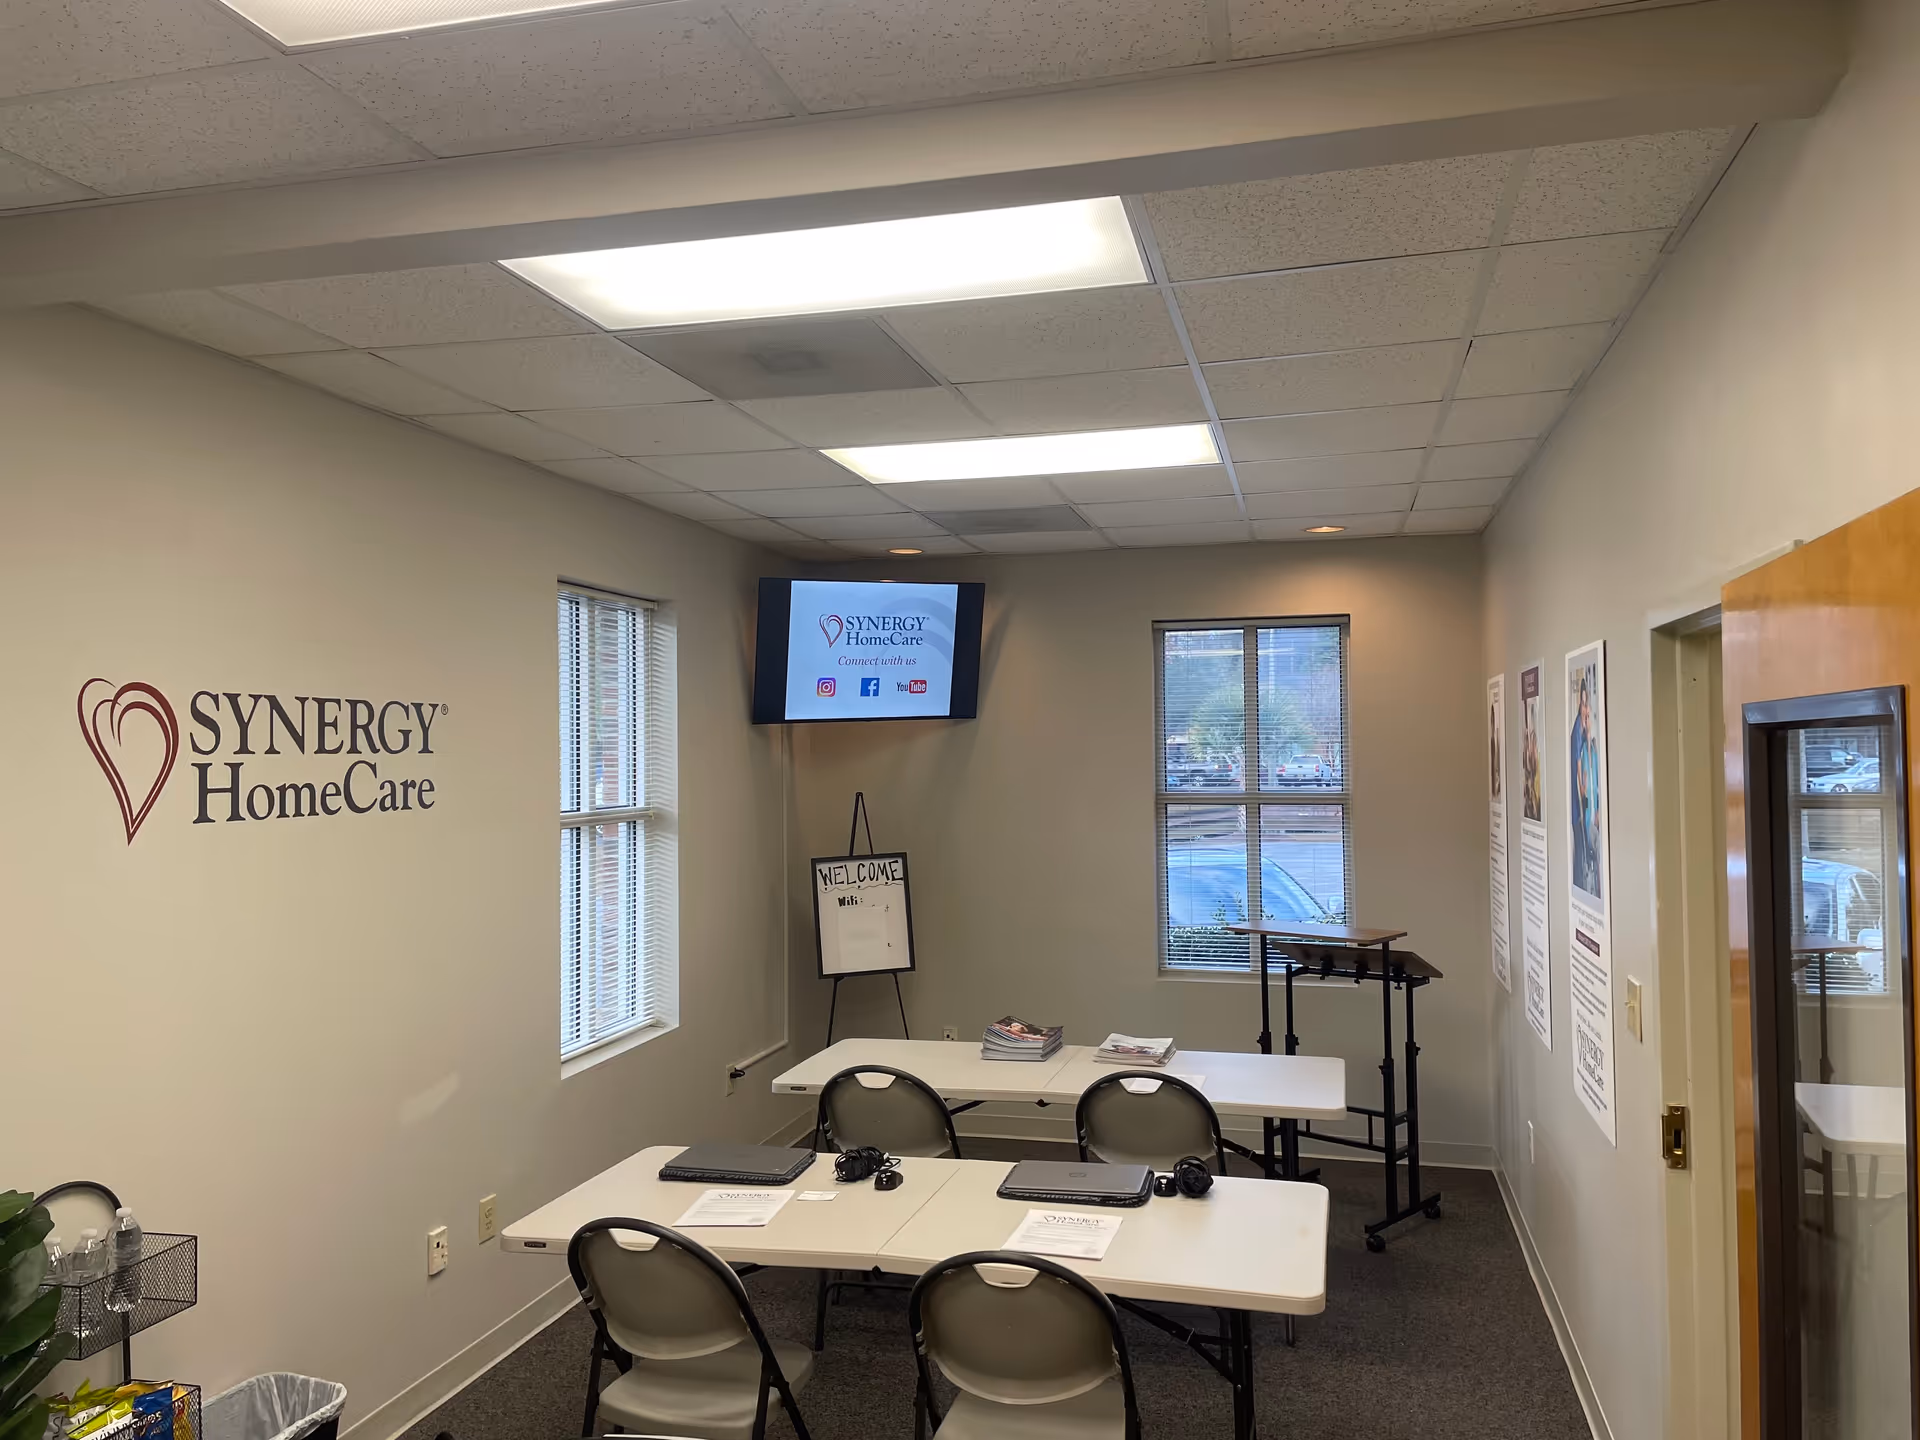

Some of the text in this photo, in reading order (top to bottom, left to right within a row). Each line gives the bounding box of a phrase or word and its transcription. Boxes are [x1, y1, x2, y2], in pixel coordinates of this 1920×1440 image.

[845, 632, 923, 646] HomeCare
[838, 655, 917, 666] Connect with us
[190, 760, 435, 824] HomeCare
[818, 860, 904, 886] WELCOME
